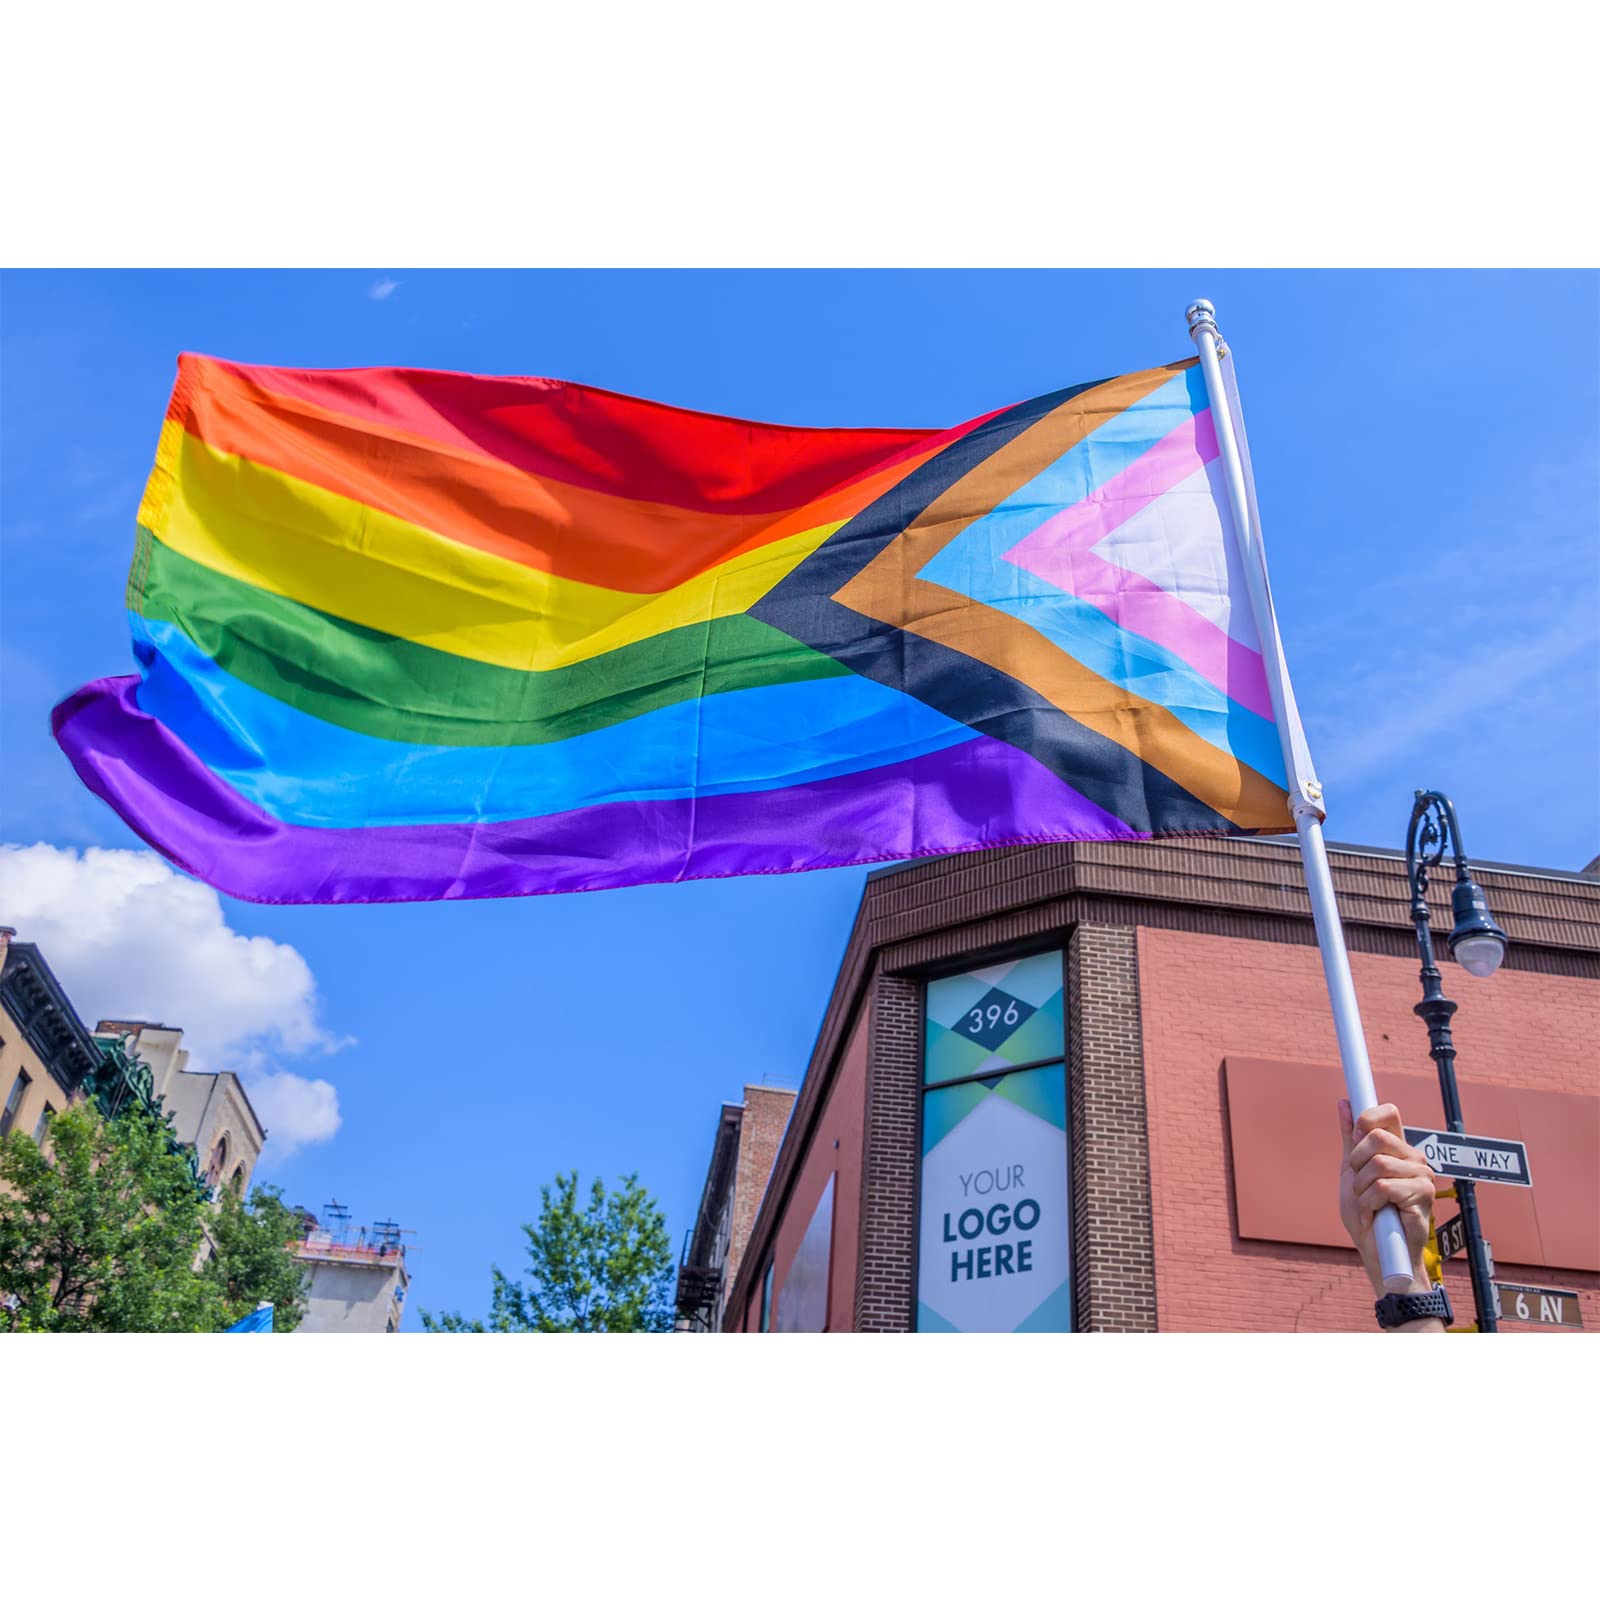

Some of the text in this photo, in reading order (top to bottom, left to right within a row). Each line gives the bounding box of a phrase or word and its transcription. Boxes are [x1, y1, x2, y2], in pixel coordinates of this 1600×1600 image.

[968, 1000, 1019, 1033] 396
[1424, 1143, 1510, 1170] ONE WAY
[959, 1164, 1025, 1197] YOUR
[943, 1198, 1041, 1243] LOGO
[1442, 1220, 1464, 1256] 8 ST
[951, 1239, 1033, 1283] HERE
[1515, 1292, 1562, 1324] 6 AV
